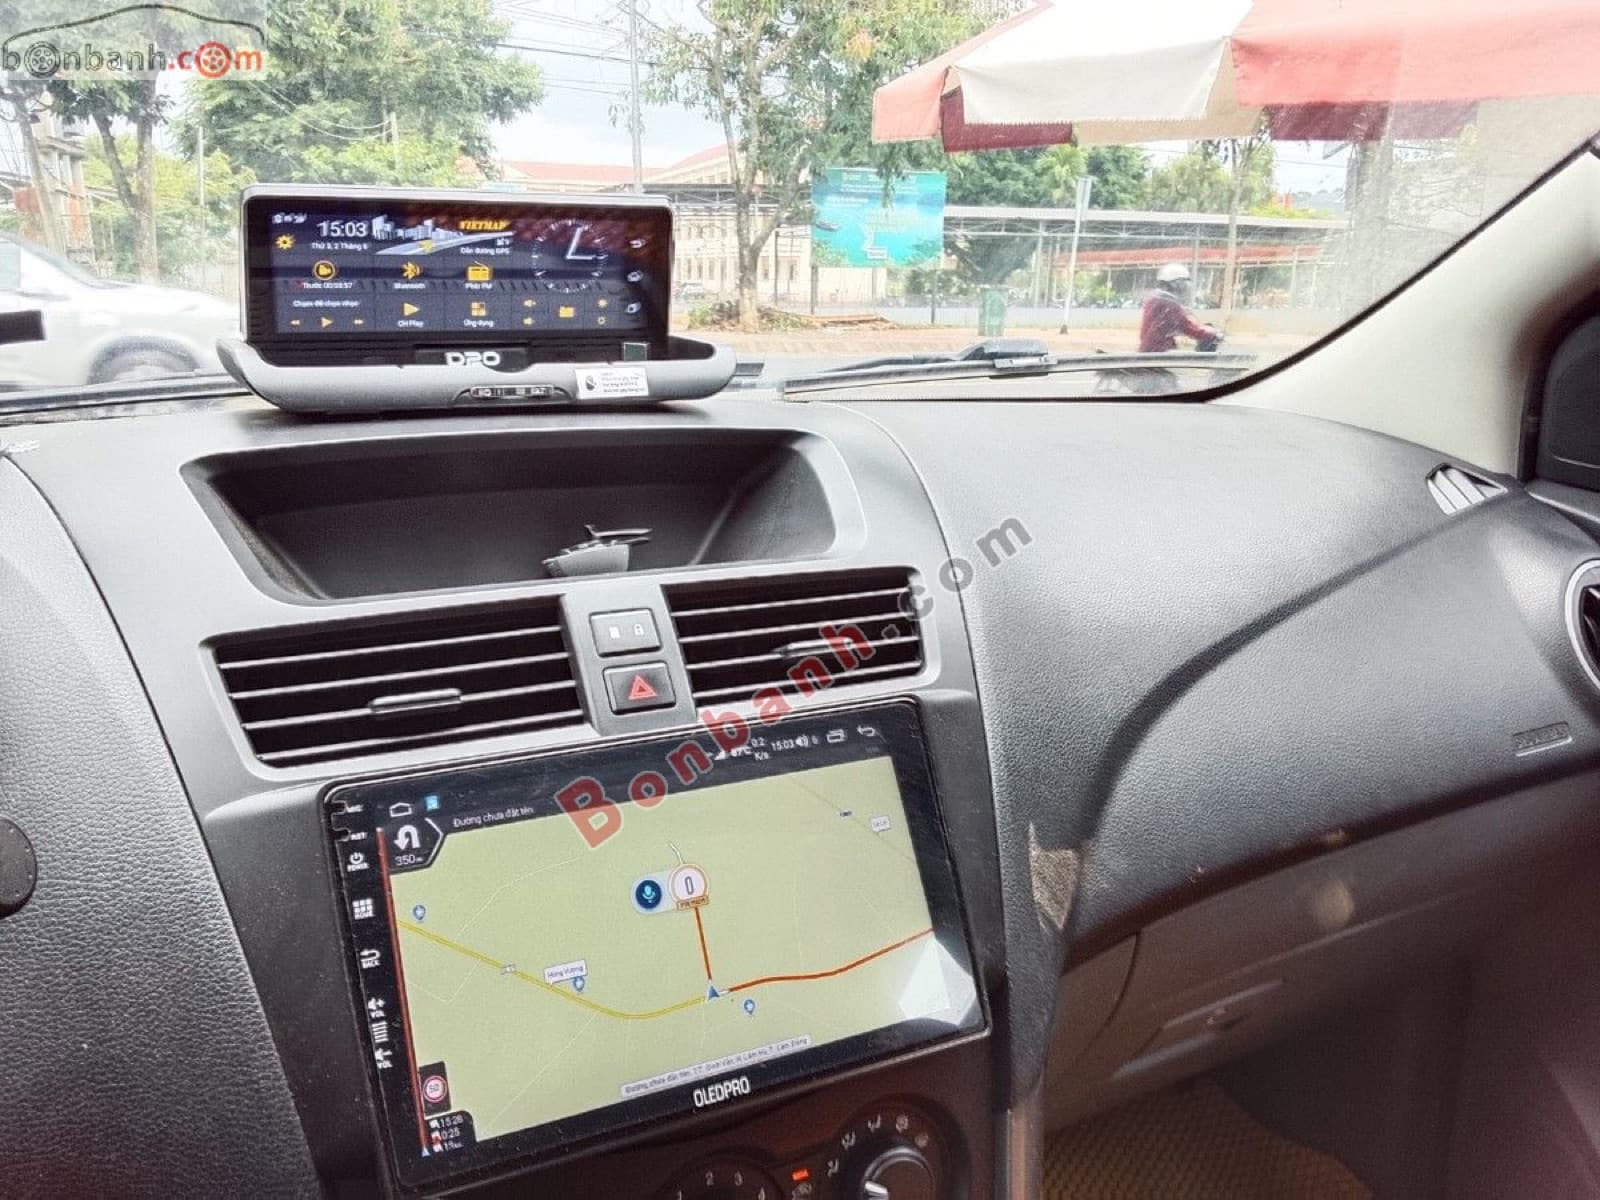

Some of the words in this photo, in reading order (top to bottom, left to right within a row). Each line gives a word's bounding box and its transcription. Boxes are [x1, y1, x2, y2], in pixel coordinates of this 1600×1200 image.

[316, 220, 369, 237] 15:03
[772, 739, 795, 751] 15:03
[685, 875, 695, 896] 0
[693, 1075, 750, 1108] OLEDPRO
